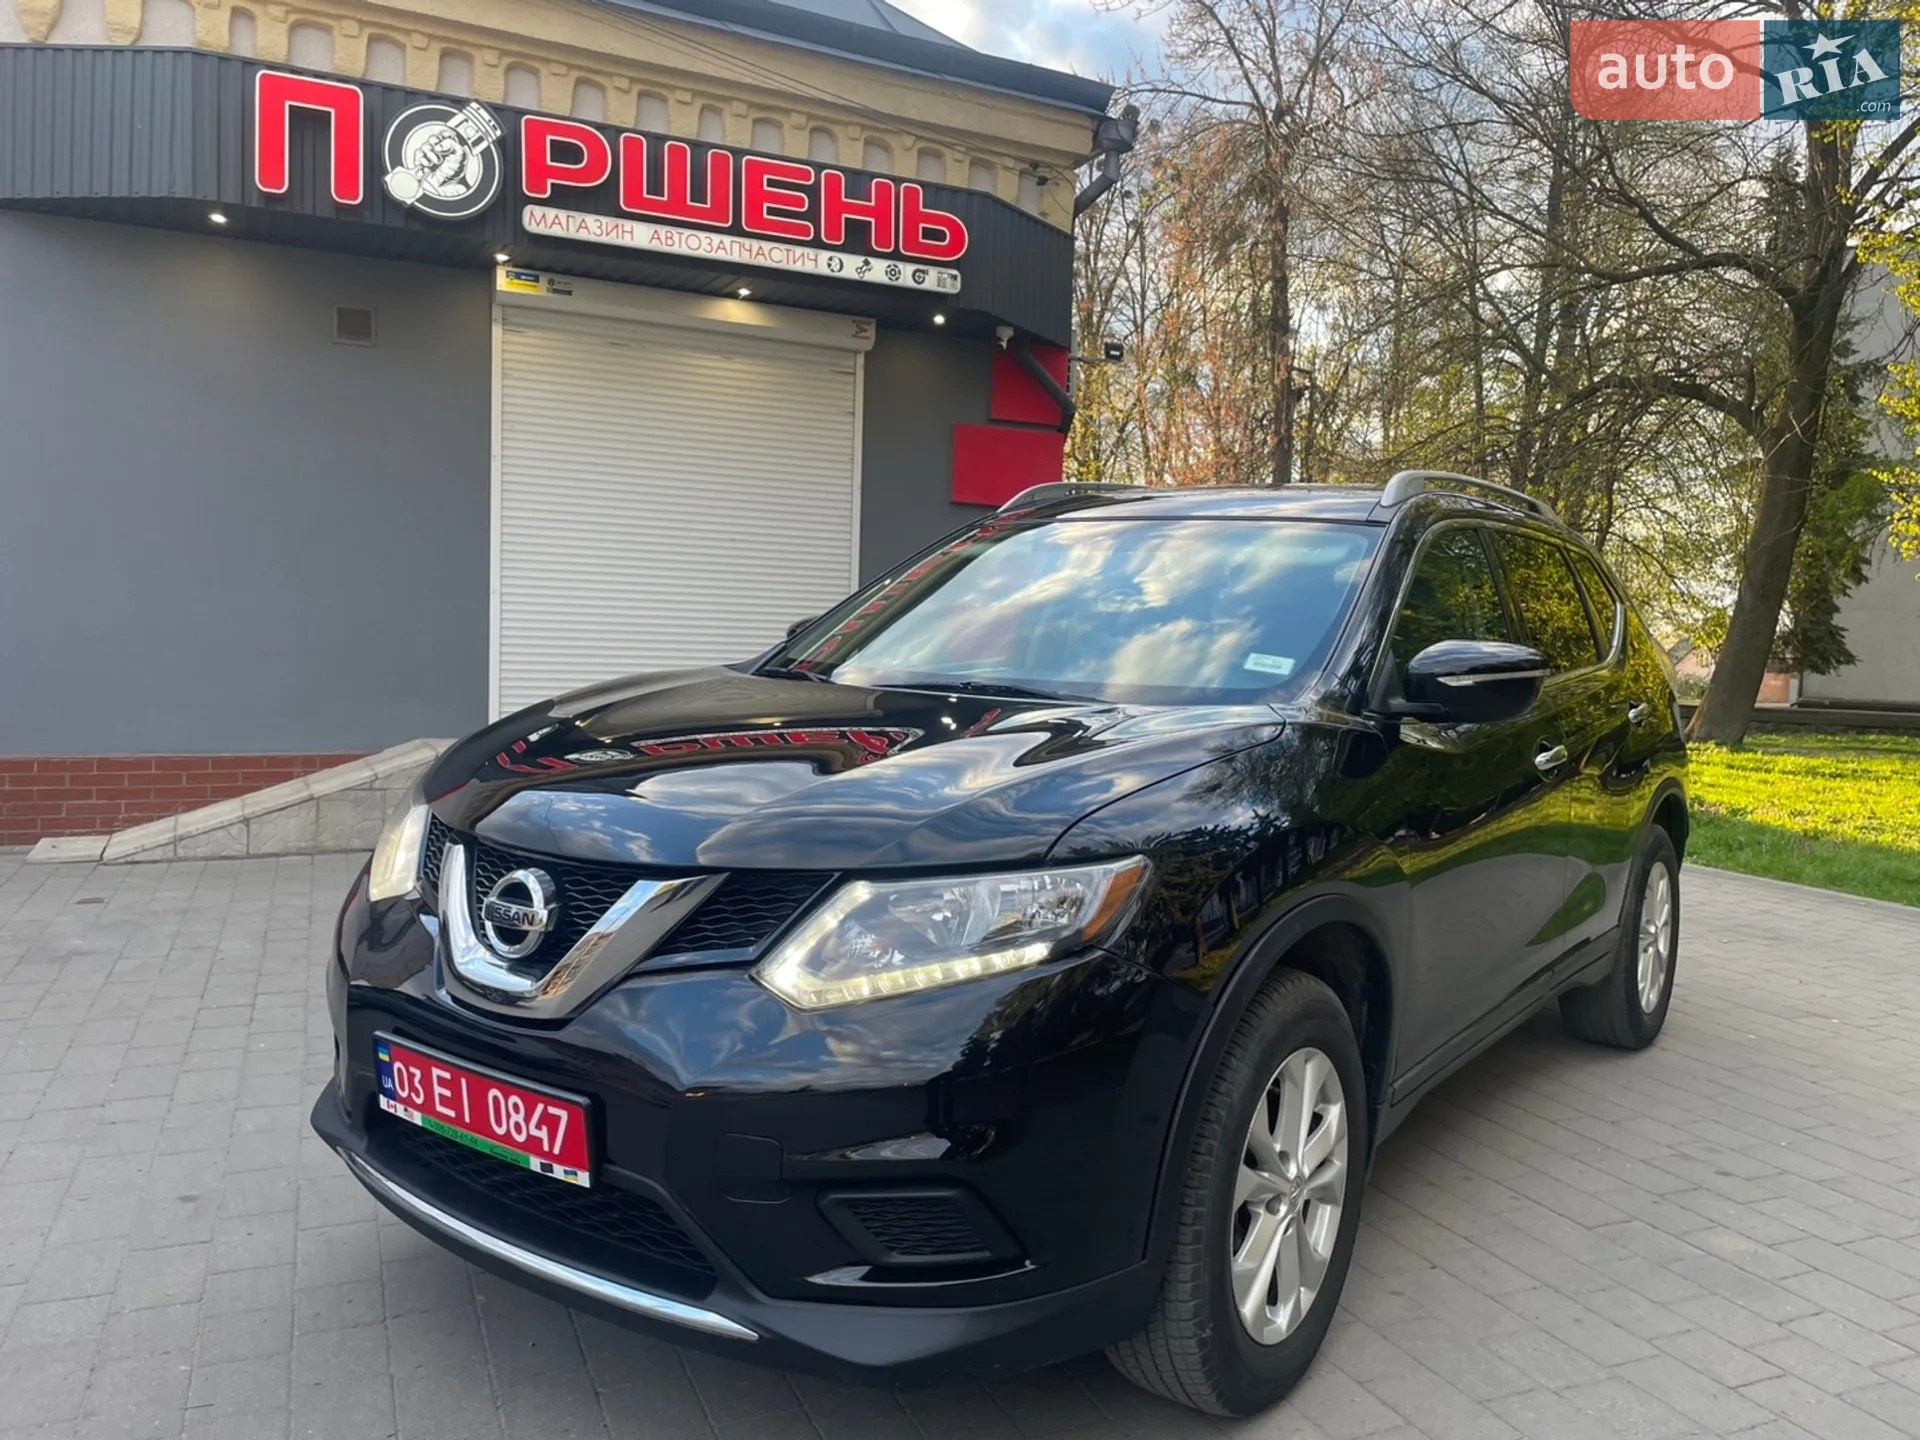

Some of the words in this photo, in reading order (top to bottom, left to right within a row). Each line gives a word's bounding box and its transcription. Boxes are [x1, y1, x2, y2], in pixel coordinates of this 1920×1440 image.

[527, 208, 635, 242] МАГАЗИН
[381, 1074, 394, 1091] UA
[393, 1061, 425, 1105] 03
[431, 1066, 470, 1124] EI
[487, 1088, 568, 1156] 0847
